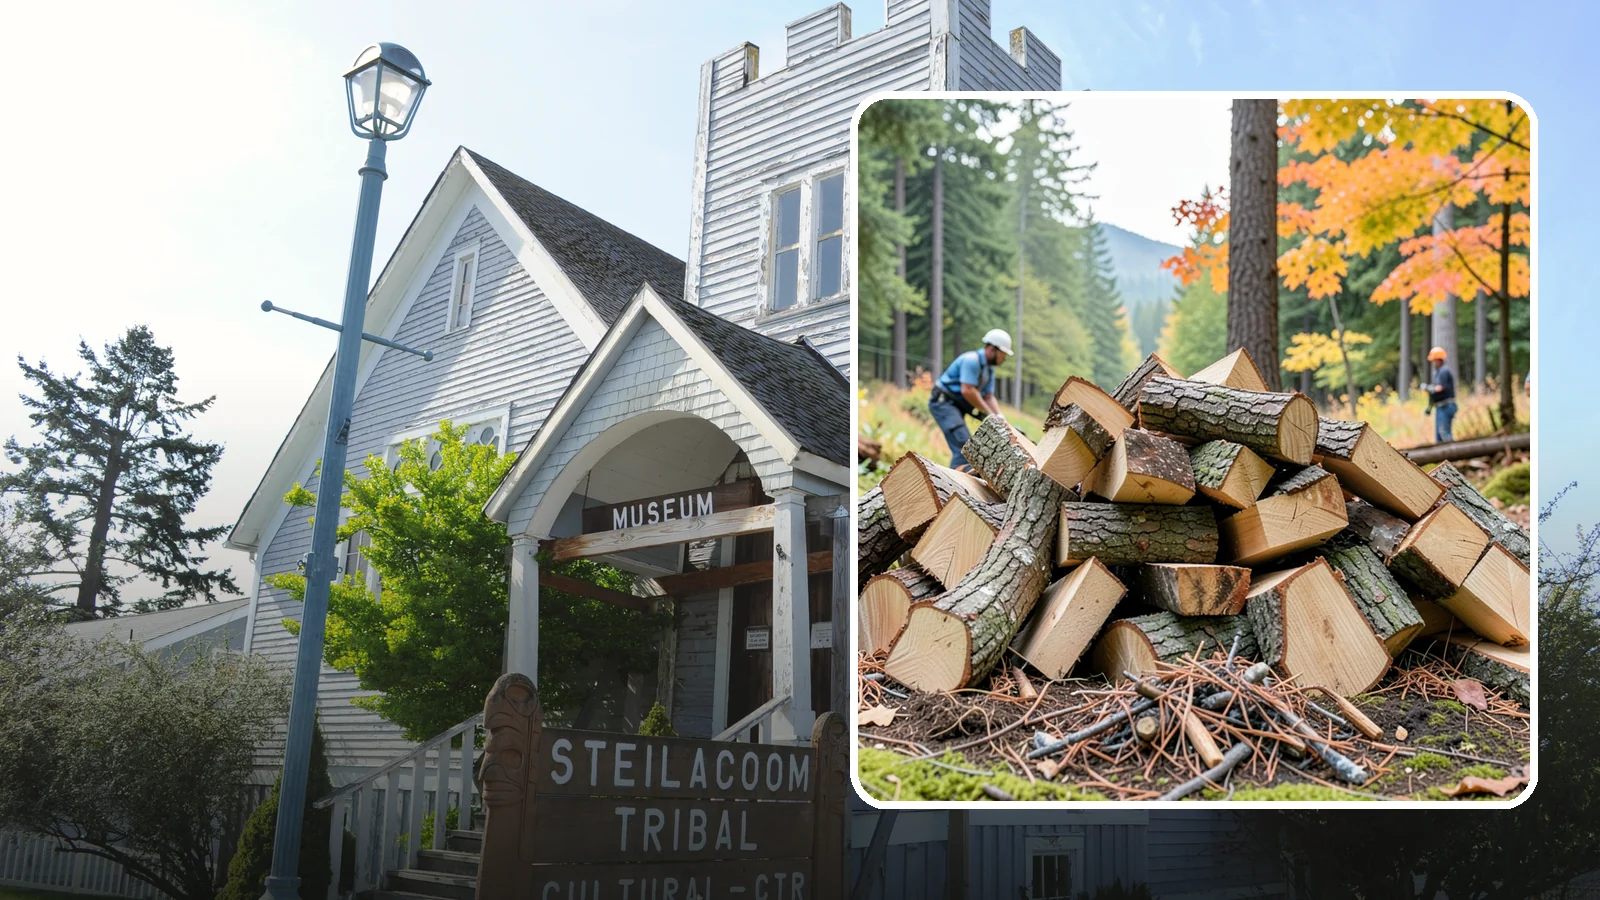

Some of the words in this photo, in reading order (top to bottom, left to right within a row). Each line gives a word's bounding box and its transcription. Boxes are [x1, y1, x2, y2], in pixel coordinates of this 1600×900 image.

[612, 491, 714, 531] MUSEUM
[550, 738, 810, 792] STEILACOOM
[615, 807, 757, 851] TRIBAL
